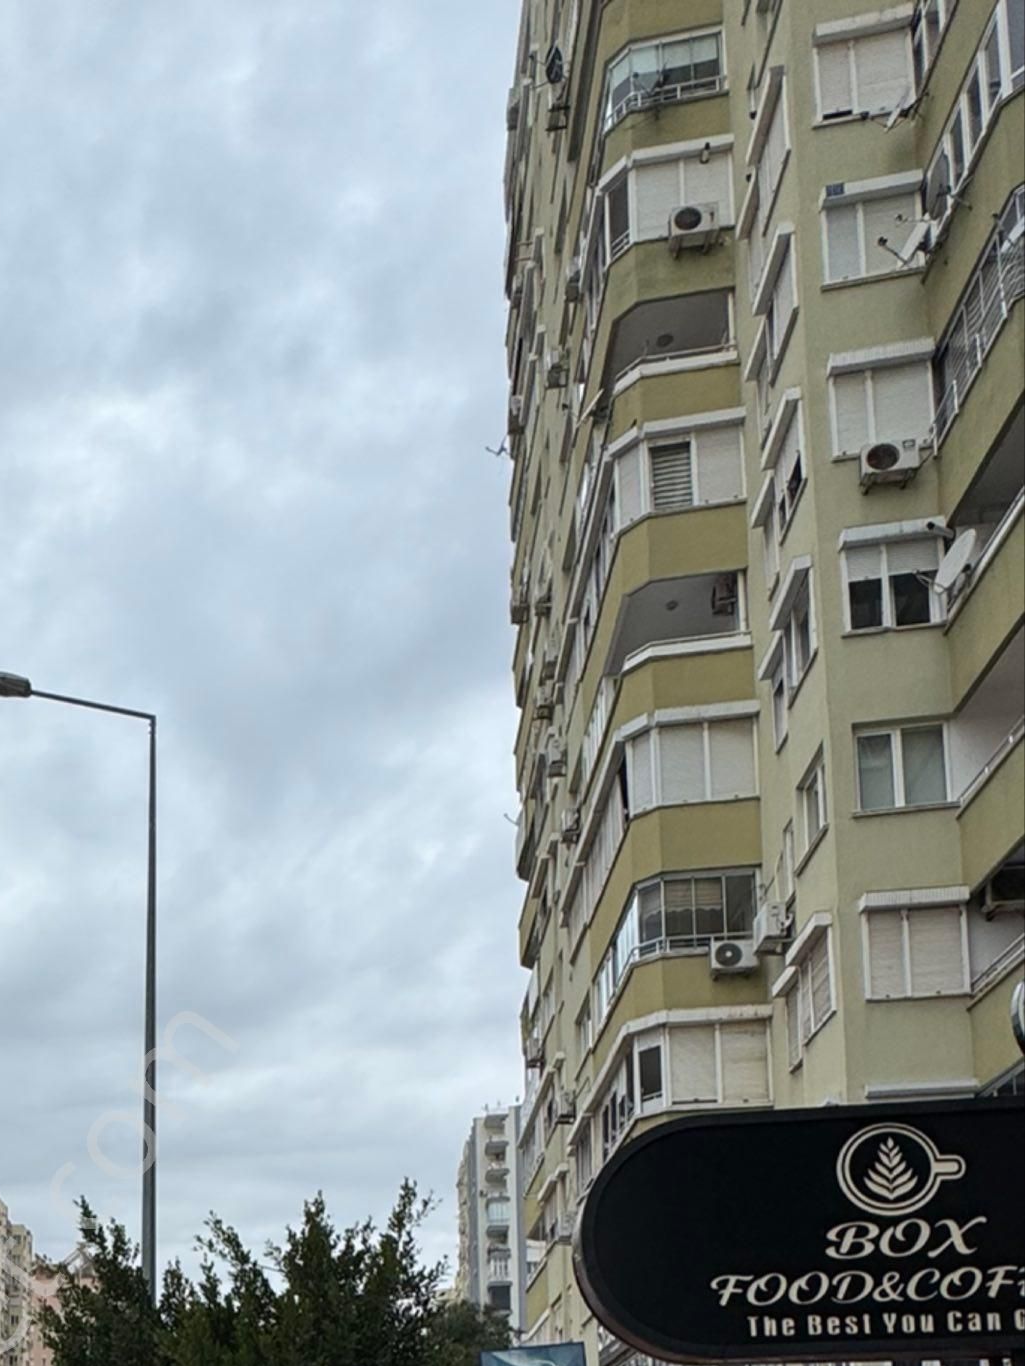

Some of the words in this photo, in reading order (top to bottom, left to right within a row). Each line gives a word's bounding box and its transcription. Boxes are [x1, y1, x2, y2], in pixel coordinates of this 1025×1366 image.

[825, 1216, 987, 1260] BOX
[747, 1315, 796, 1338] The
[807, 1313, 872, 1336] Best
[882, 1311, 934, 1334] You
[947, 1309, 1002, 1333] Can
